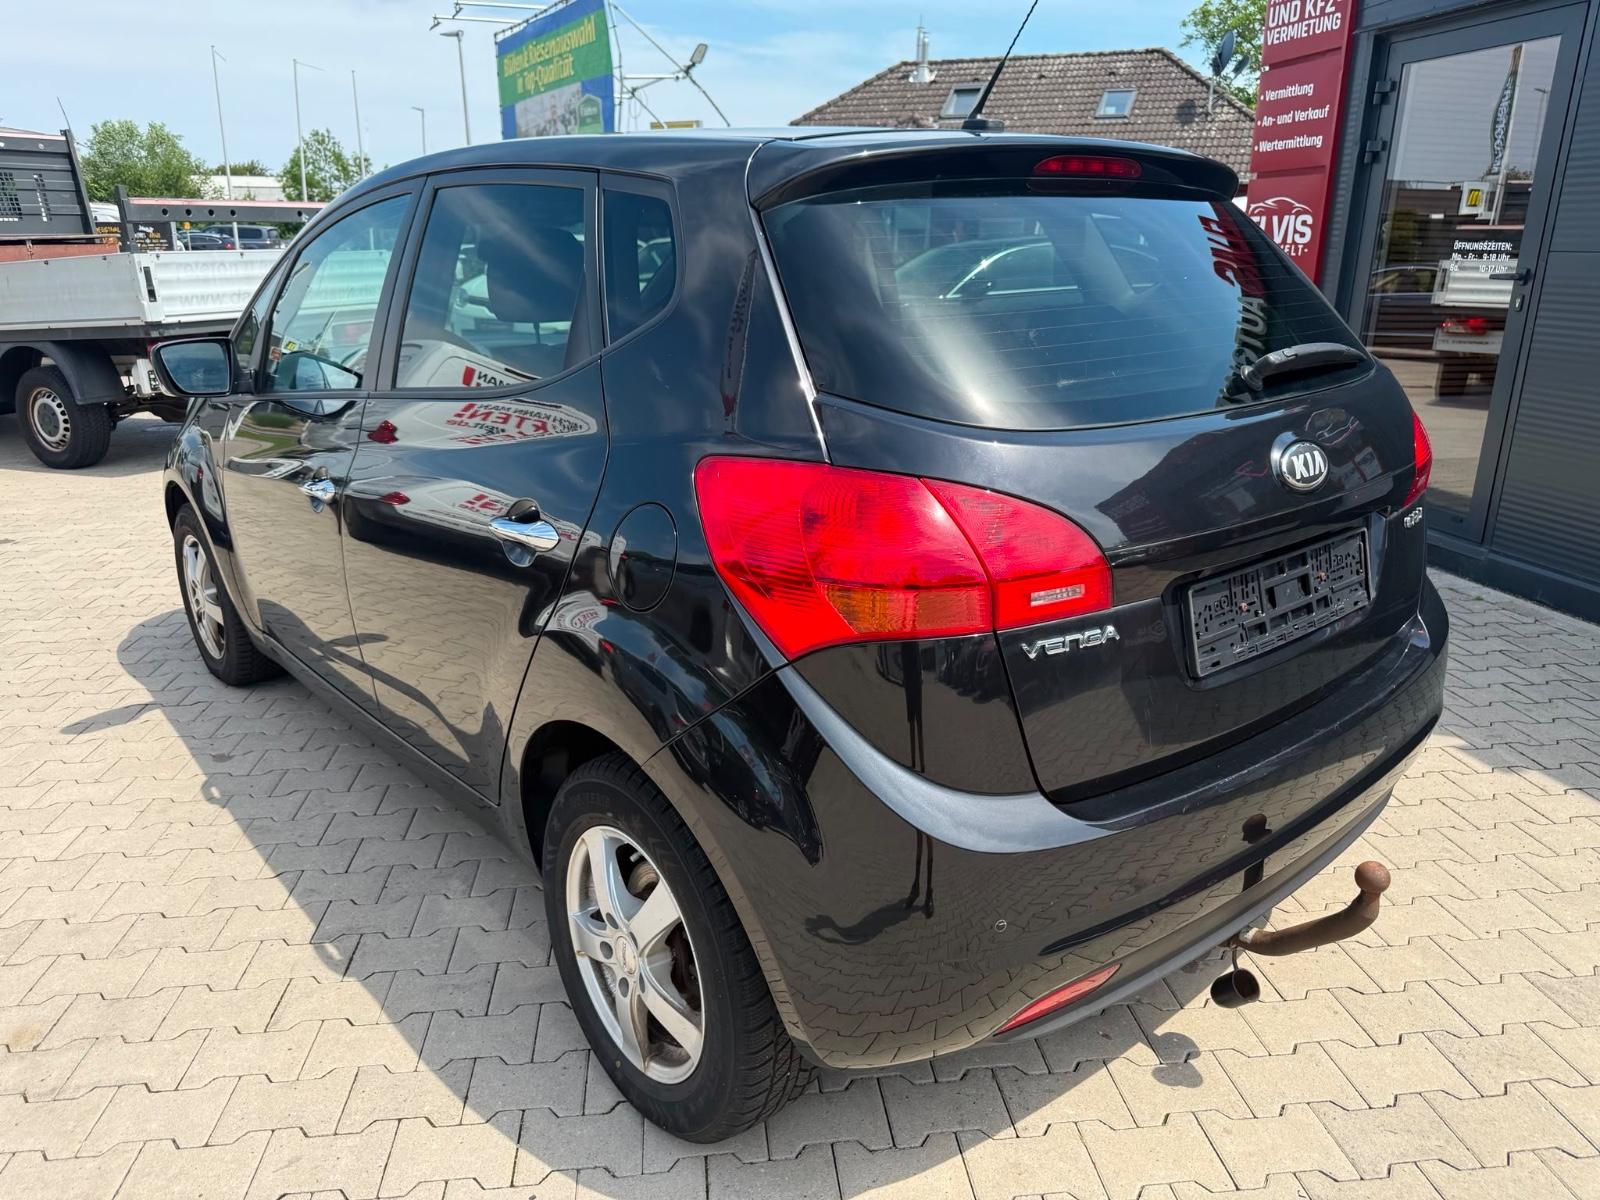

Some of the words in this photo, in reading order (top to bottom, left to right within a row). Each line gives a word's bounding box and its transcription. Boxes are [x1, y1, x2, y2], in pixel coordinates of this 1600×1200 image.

[1268, 0, 1301, 28] UND
[1267, 12, 1342, 46] VERMIETUNG
[1265, 83, 1314, 101] Vermittlung
[1261, 115, 1276, 127] An-
[1276, 110, 1293, 125] und
[1294, 104, 1330, 122] Verkauf
[1259, 134, 1323, 152] Wertermittlung
[1249, 214, 1313, 244] VIS
[1453, 240, 1513, 251] ÖFFNUNGSZEITEN:
[1498, 253, 1511, 262] Uhr
[1291, 450, 1325, 480] KIA
